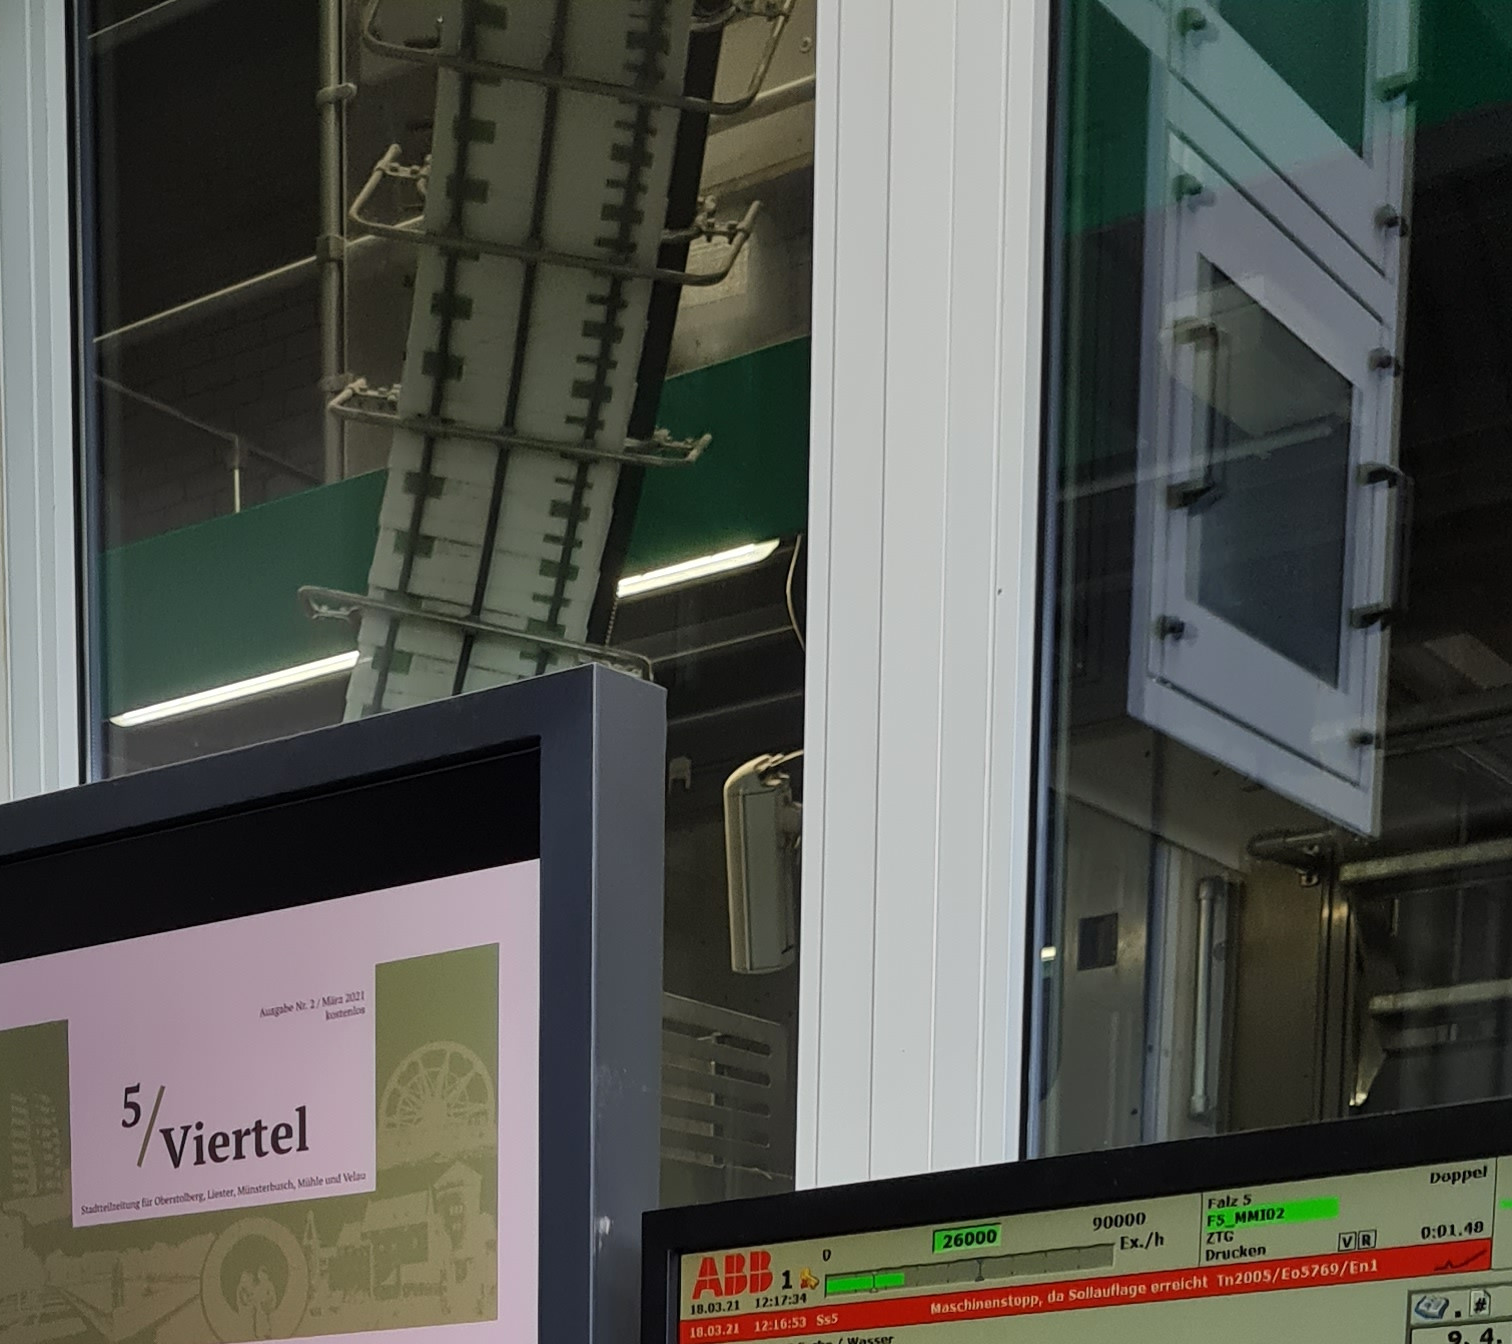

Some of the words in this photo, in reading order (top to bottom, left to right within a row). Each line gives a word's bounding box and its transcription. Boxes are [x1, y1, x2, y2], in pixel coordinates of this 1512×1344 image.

[295, 1000, 308, 1012] Nr.
[310, 999, 315, 1009] 2
[322, 994, 343, 1008] März
[345, 991, 365, 1004] 2021
[326, 1006, 365, 1021] kostenlos
[1430, 1166, 1488, 1184] Doppel
[141, 1197, 153, 1207] für
[207, 1187, 236, 1199] Liester,
[237, 1179, 296, 1196] Münsterbusch,
[297, 1176, 323, 1188] Mühle
[325, 1174, 341, 1184] und
[343, 1171, 366, 1182] Velau
[1207, 1196, 1238, 1209] Falz
[1243, 1195, 1252, 1205] 5
[1092, 1212, 1146, 1232] 90000
[942, 1229, 997, 1249] 26000
[1120, 1232, 1164, 1250] Ex./h
[1206, 1231, 1234, 1244] ZTG
[1342, 1236, 1353, 1248] V
[1362, 1233, 1371, 1246] R
[822, 1250, 831, 1261] 0
[1205, 1245, 1266, 1261] Drucken
[692, 1251, 773, 1300] ABB
[782, 1270, 792, 1290] 1
[690, 1300, 740, 1315] 18.03.21
[754, 1294, 806, 1308] 12:17:34
[690, 1323, 739, 1338] 18.03.21
[754, 1317, 806, 1332] 12:16:53
[816, 1314, 838, 1326] Ss5
[930, 1294, 1043, 1314] Maschinenstopp,
[1047, 1289, 1064, 1302] da
[1068, 1282, 1146, 1300] Sollauflage
[1151, 1278, 1208, 1292] erreicht
